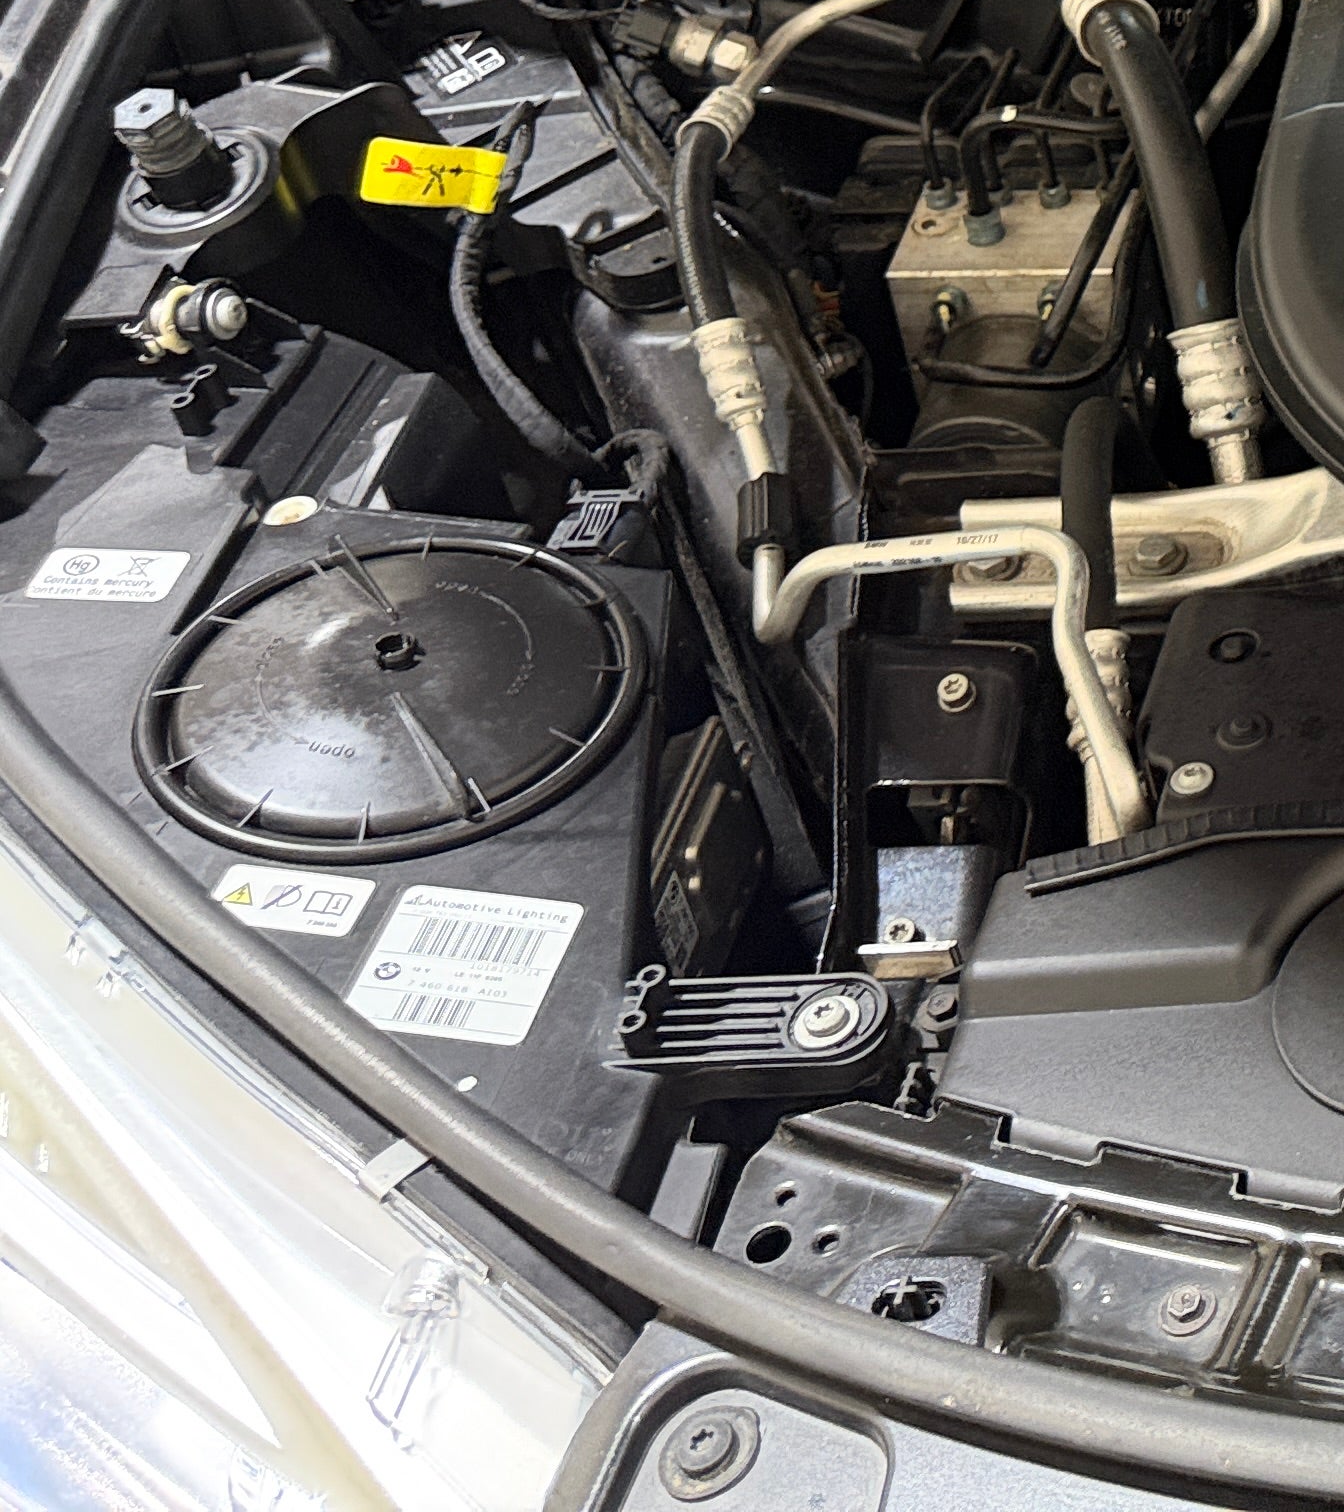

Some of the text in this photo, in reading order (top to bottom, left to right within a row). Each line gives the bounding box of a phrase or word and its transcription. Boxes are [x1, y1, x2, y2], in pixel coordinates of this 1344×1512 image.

[70, 559, 91, 574] Hg
[43, 575, 153, 588] Contains mercury
[87, 587, 103, 596] du
[107, 589, 156, 598] mercure
[425, 896, 502, 915] Automotive
[507, 907, 569, 924] Lighting
